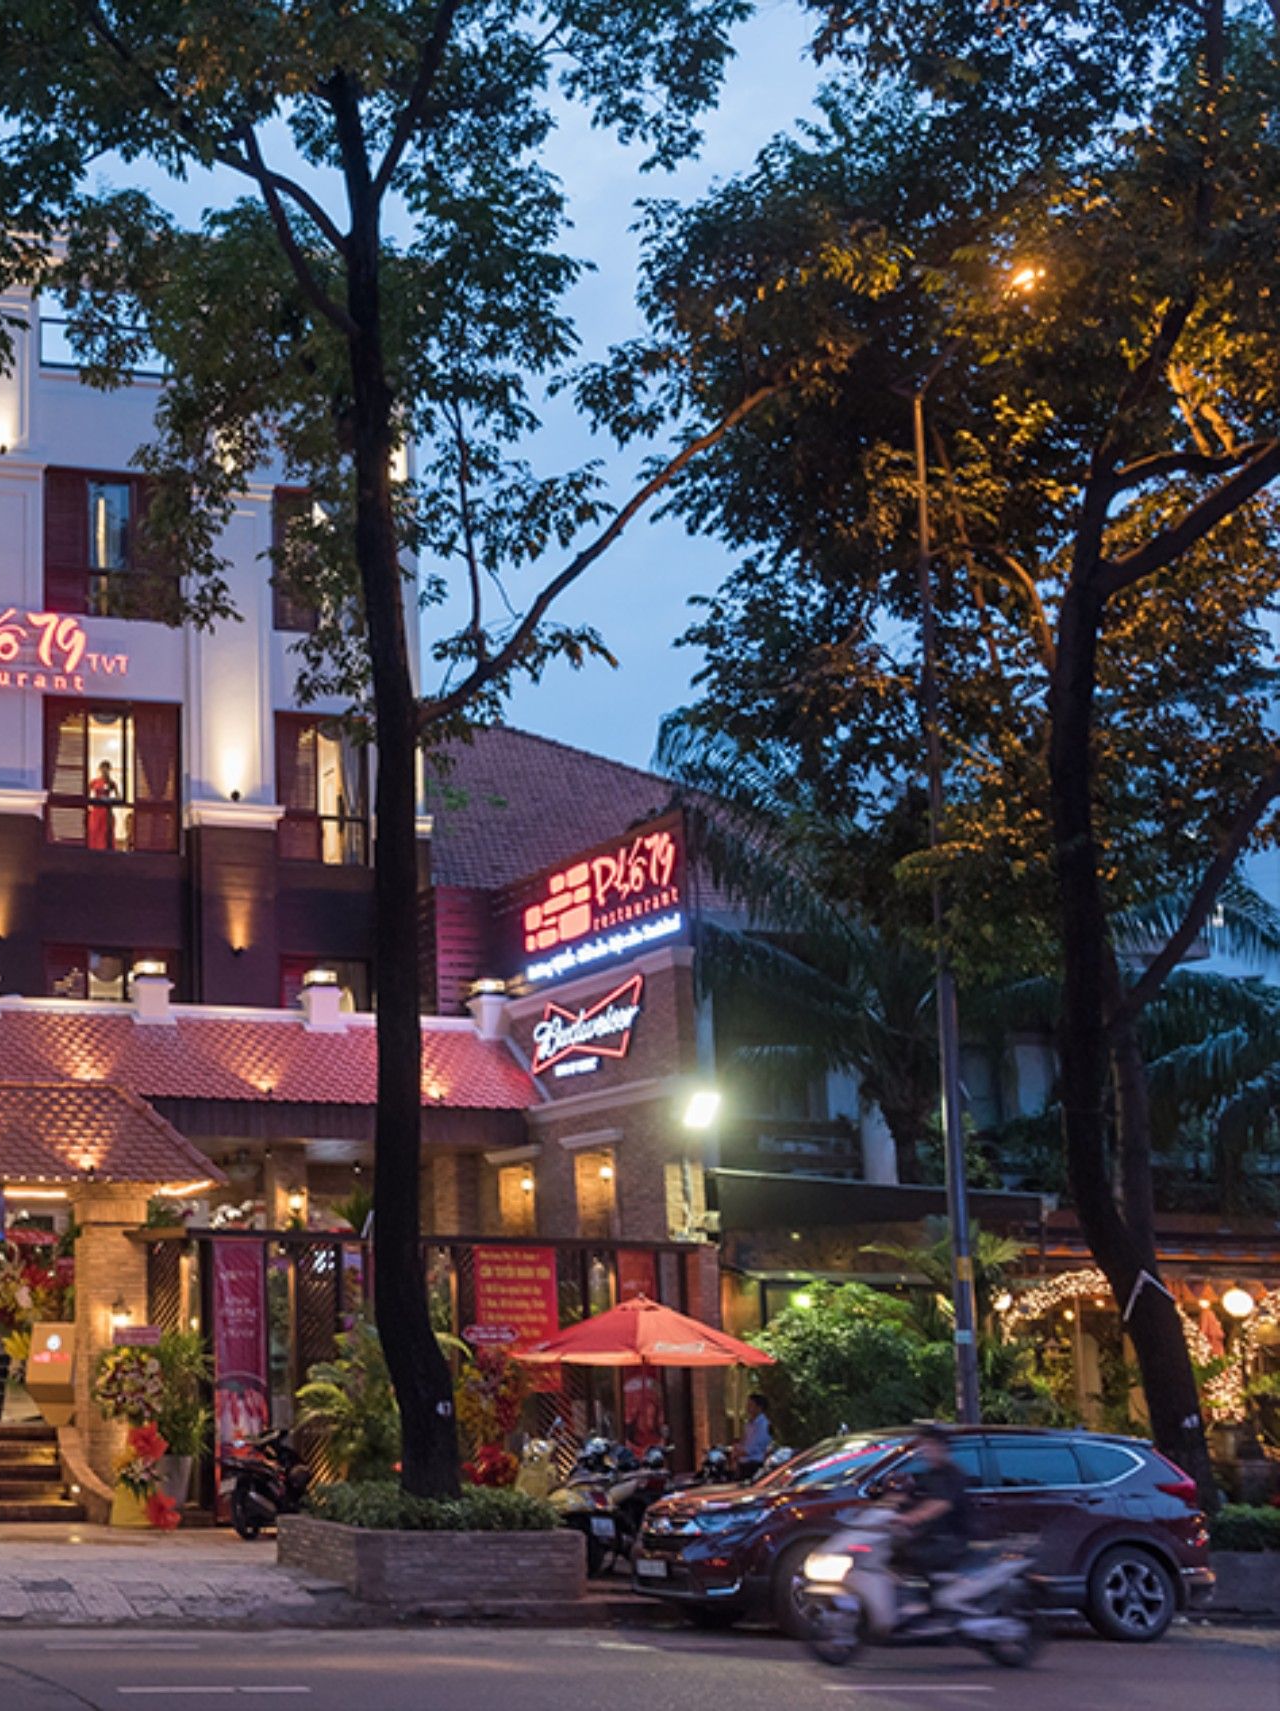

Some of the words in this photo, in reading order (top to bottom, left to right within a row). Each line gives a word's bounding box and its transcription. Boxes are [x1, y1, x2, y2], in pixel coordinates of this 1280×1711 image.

[26, 611, 87, 674] 79
[87, 652, 129, 676] TVT
[643, 831, 676, 888] 79
[533, 1003, 640, 1060] Budweiser
